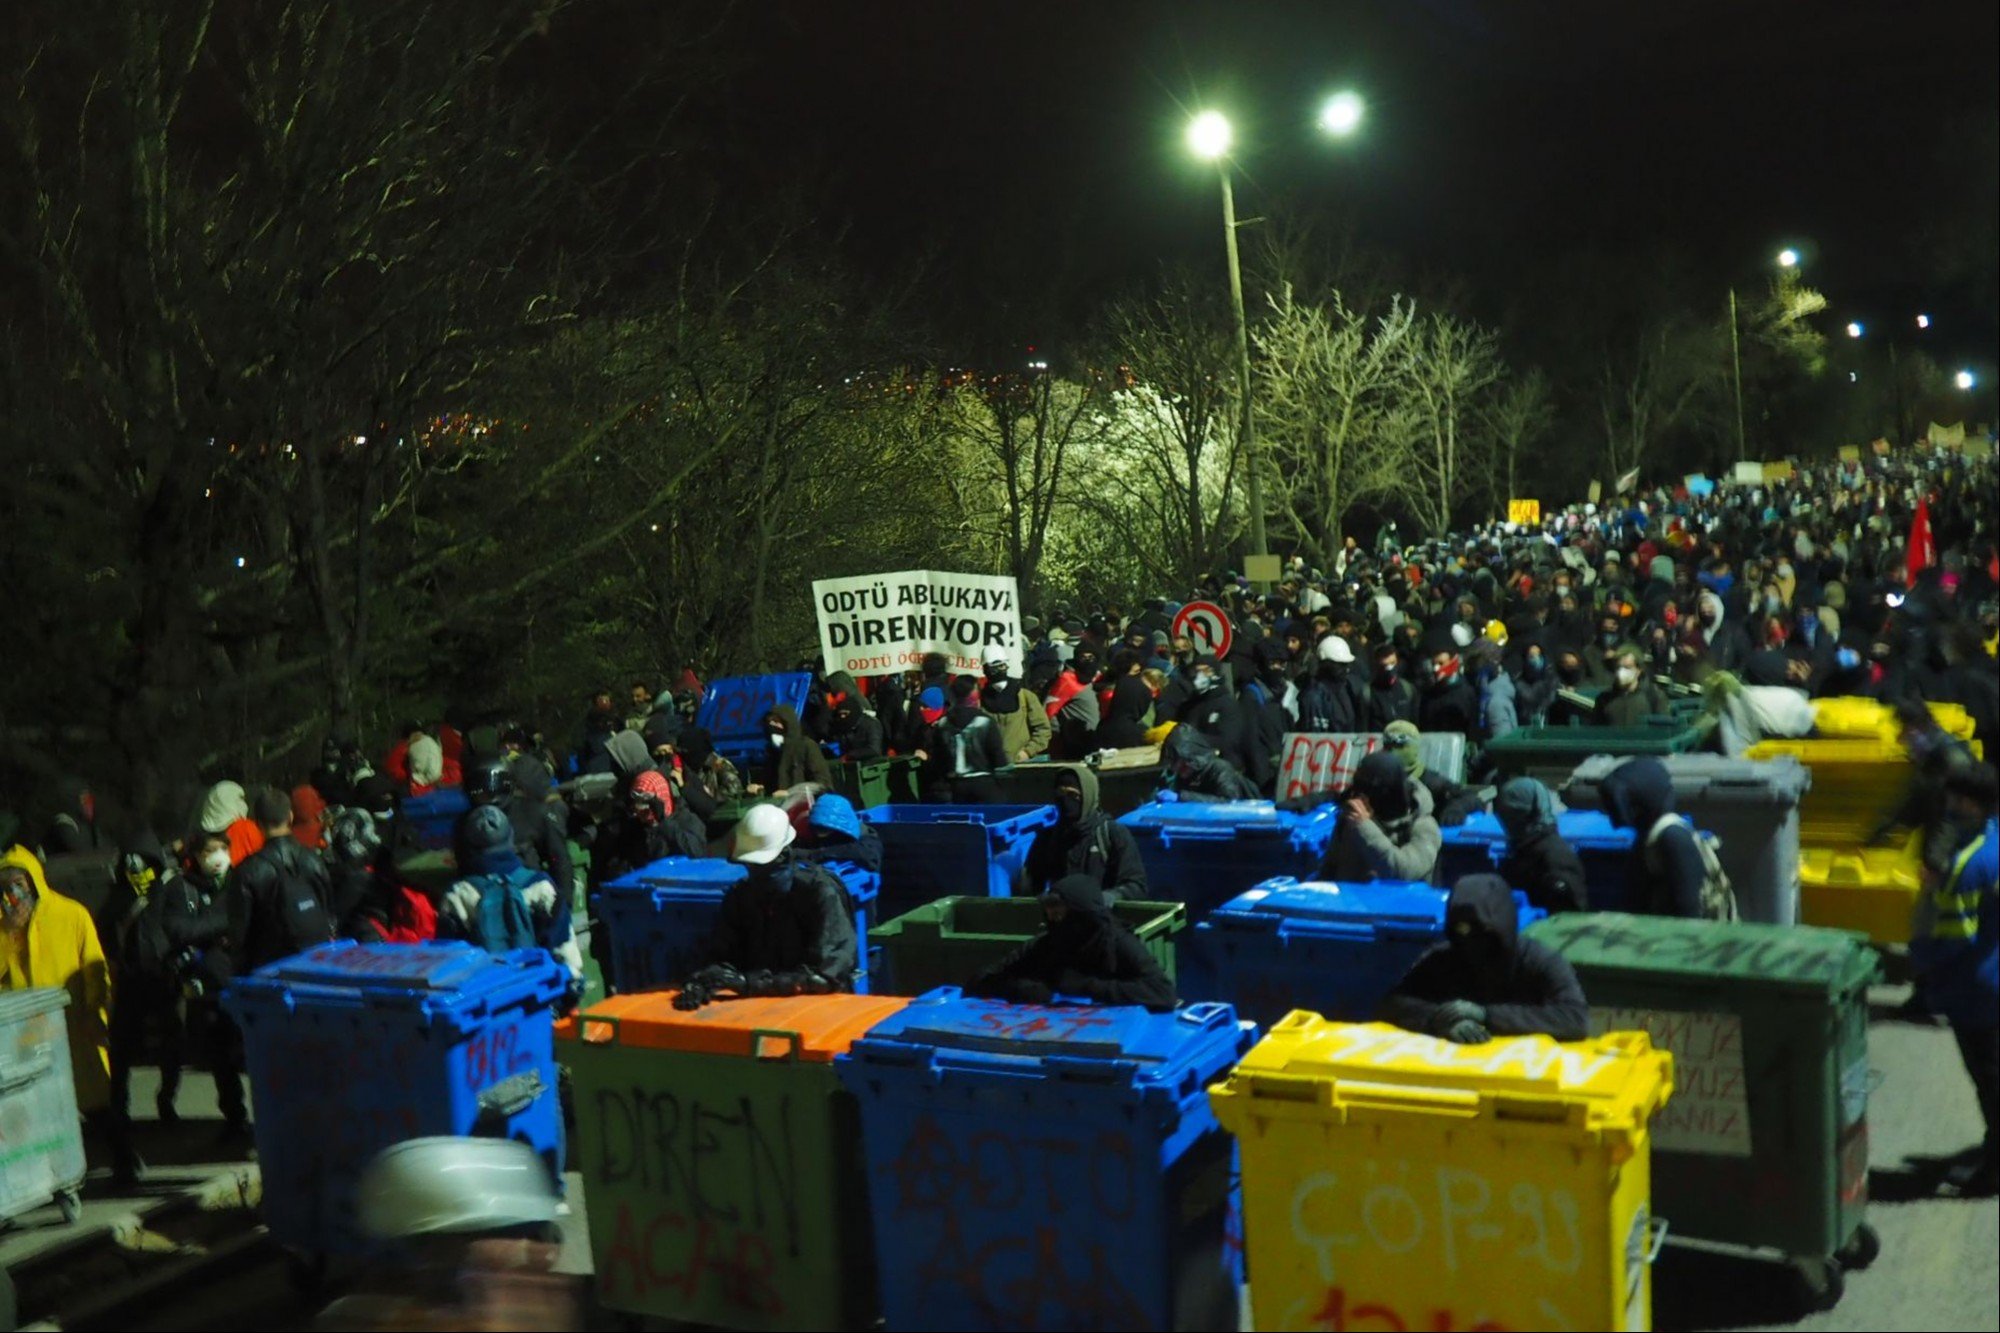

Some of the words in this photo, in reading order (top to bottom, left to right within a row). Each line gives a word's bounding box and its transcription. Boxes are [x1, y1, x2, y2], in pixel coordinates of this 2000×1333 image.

[822, 581, 888, 614] ODTÜ
[828, 607, 1015, 648] DİRENİYOR!
[847, 651, 892, 671] ODTÜ
[898, 649, 984, 671] ÖĞRCİLE
